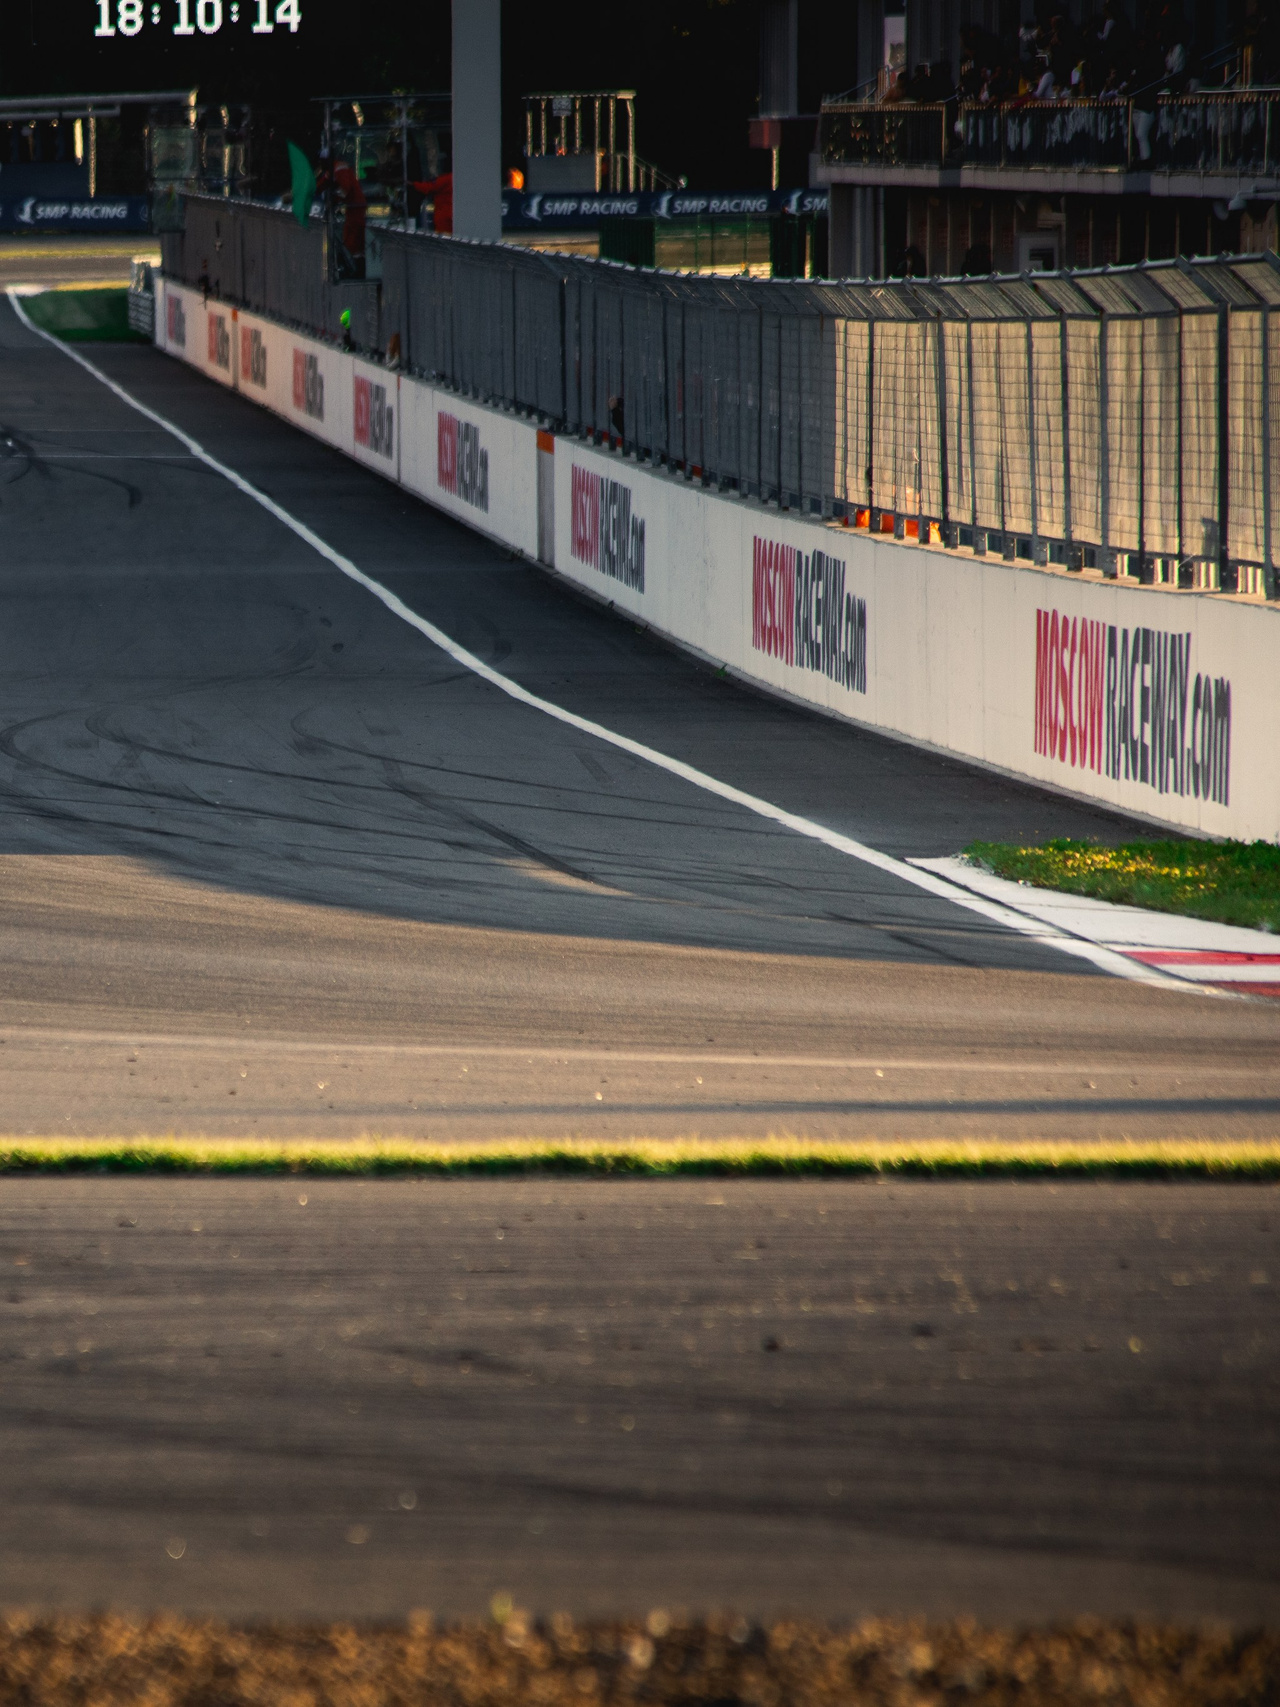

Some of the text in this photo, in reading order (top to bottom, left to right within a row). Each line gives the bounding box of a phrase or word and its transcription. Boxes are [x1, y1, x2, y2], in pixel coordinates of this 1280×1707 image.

[94, 0, 302, 37] 18:10:14
[35, 203, 128, 220] SMP RACING
[542, 201, 638, 216] SMP RACING
[672, 198, 768, 214] SMP RACING
[802, 197, 828, 211] SM
